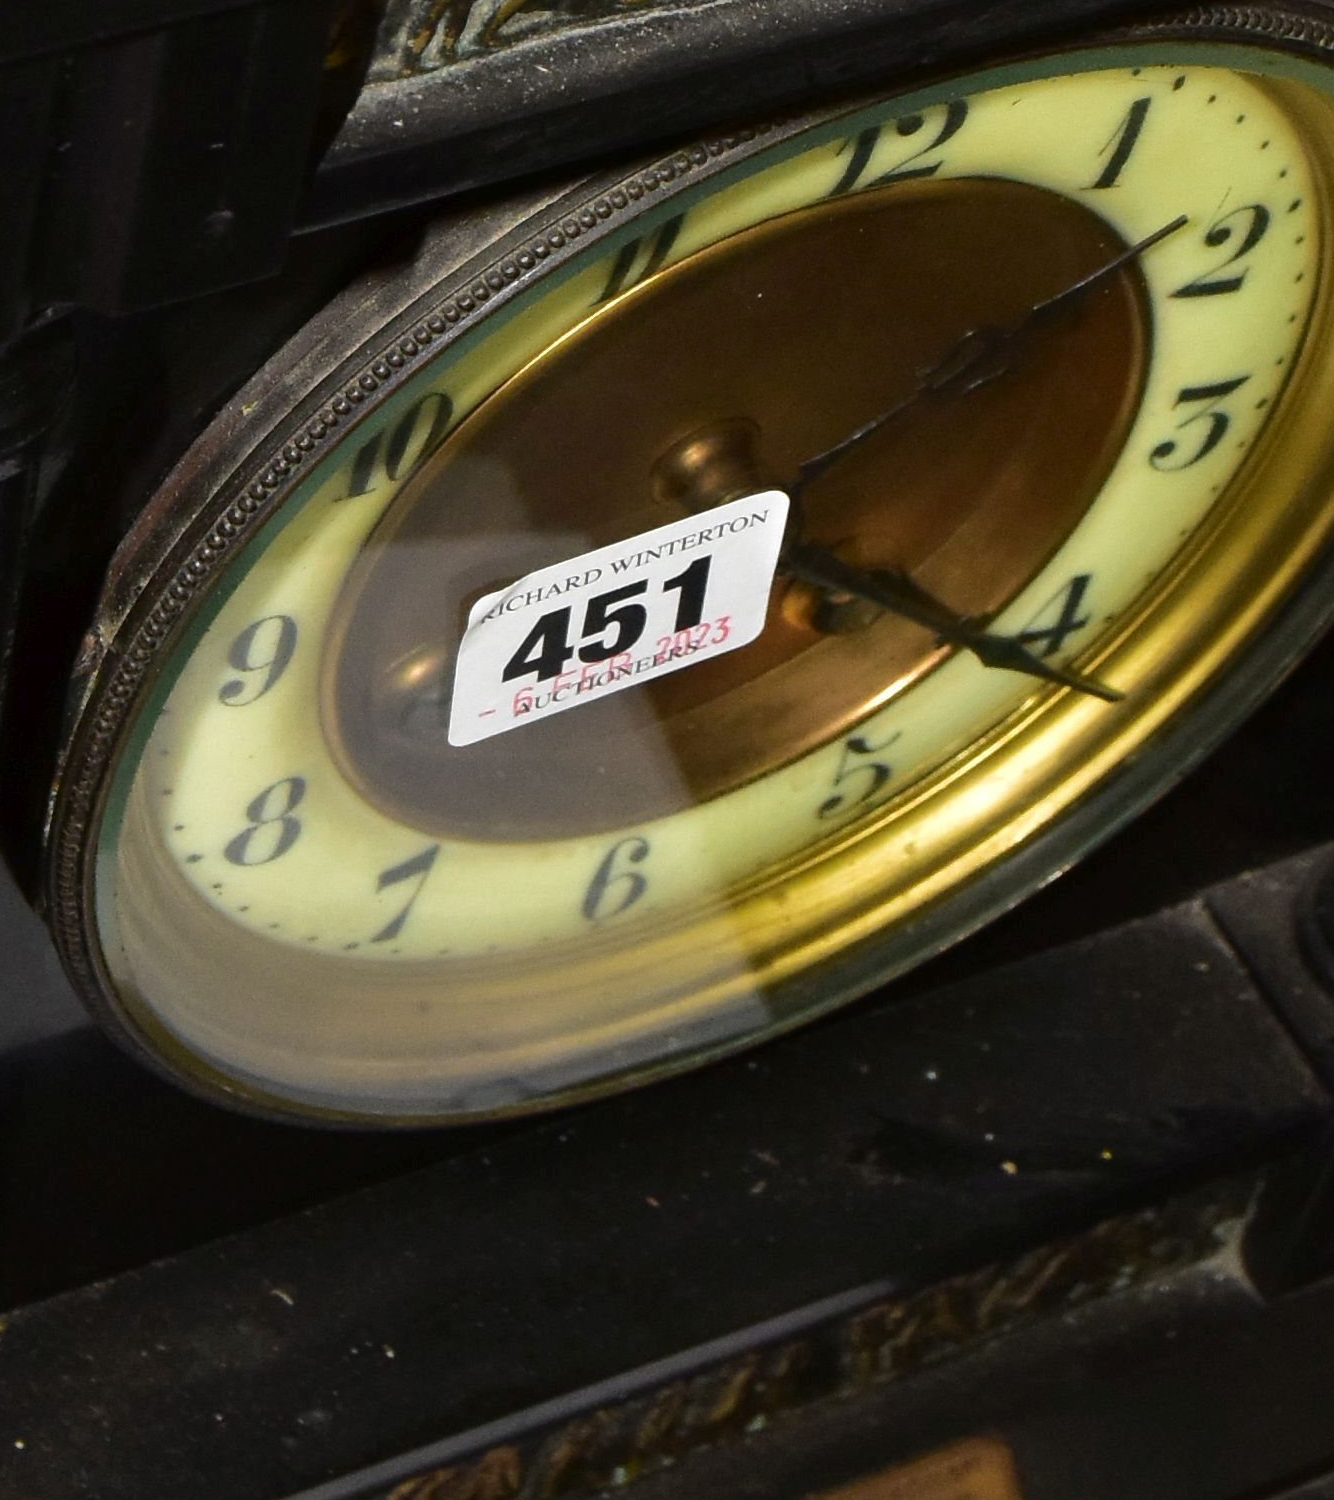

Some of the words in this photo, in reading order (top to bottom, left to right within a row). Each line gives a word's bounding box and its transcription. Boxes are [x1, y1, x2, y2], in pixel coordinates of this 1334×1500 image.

[829, 100, 968, 197] 12
[1080, 96, 1152, 190] 1
[1168, 187, 1270, 298] 2
[334, 392, 454, 503] 10
[1149, 374, 1252, 472] 3
[480, 567, 603, 625] RICHARD
[609, 509, 772, 576] WINTERTON
[218, 614, 298, 707] 9
[501, 553, 713, 684] 451
[654, 615, 731, 665] 2023
[1019, 573, 1091, 662] 4
[513, 637, 703, 718] AUCTIONEERS
[223, 775, 307, 867] 8
[817, 730, 903, 820] 5
[370, 843, 442, 924] 7
[581, 836, 651, 922] 6
